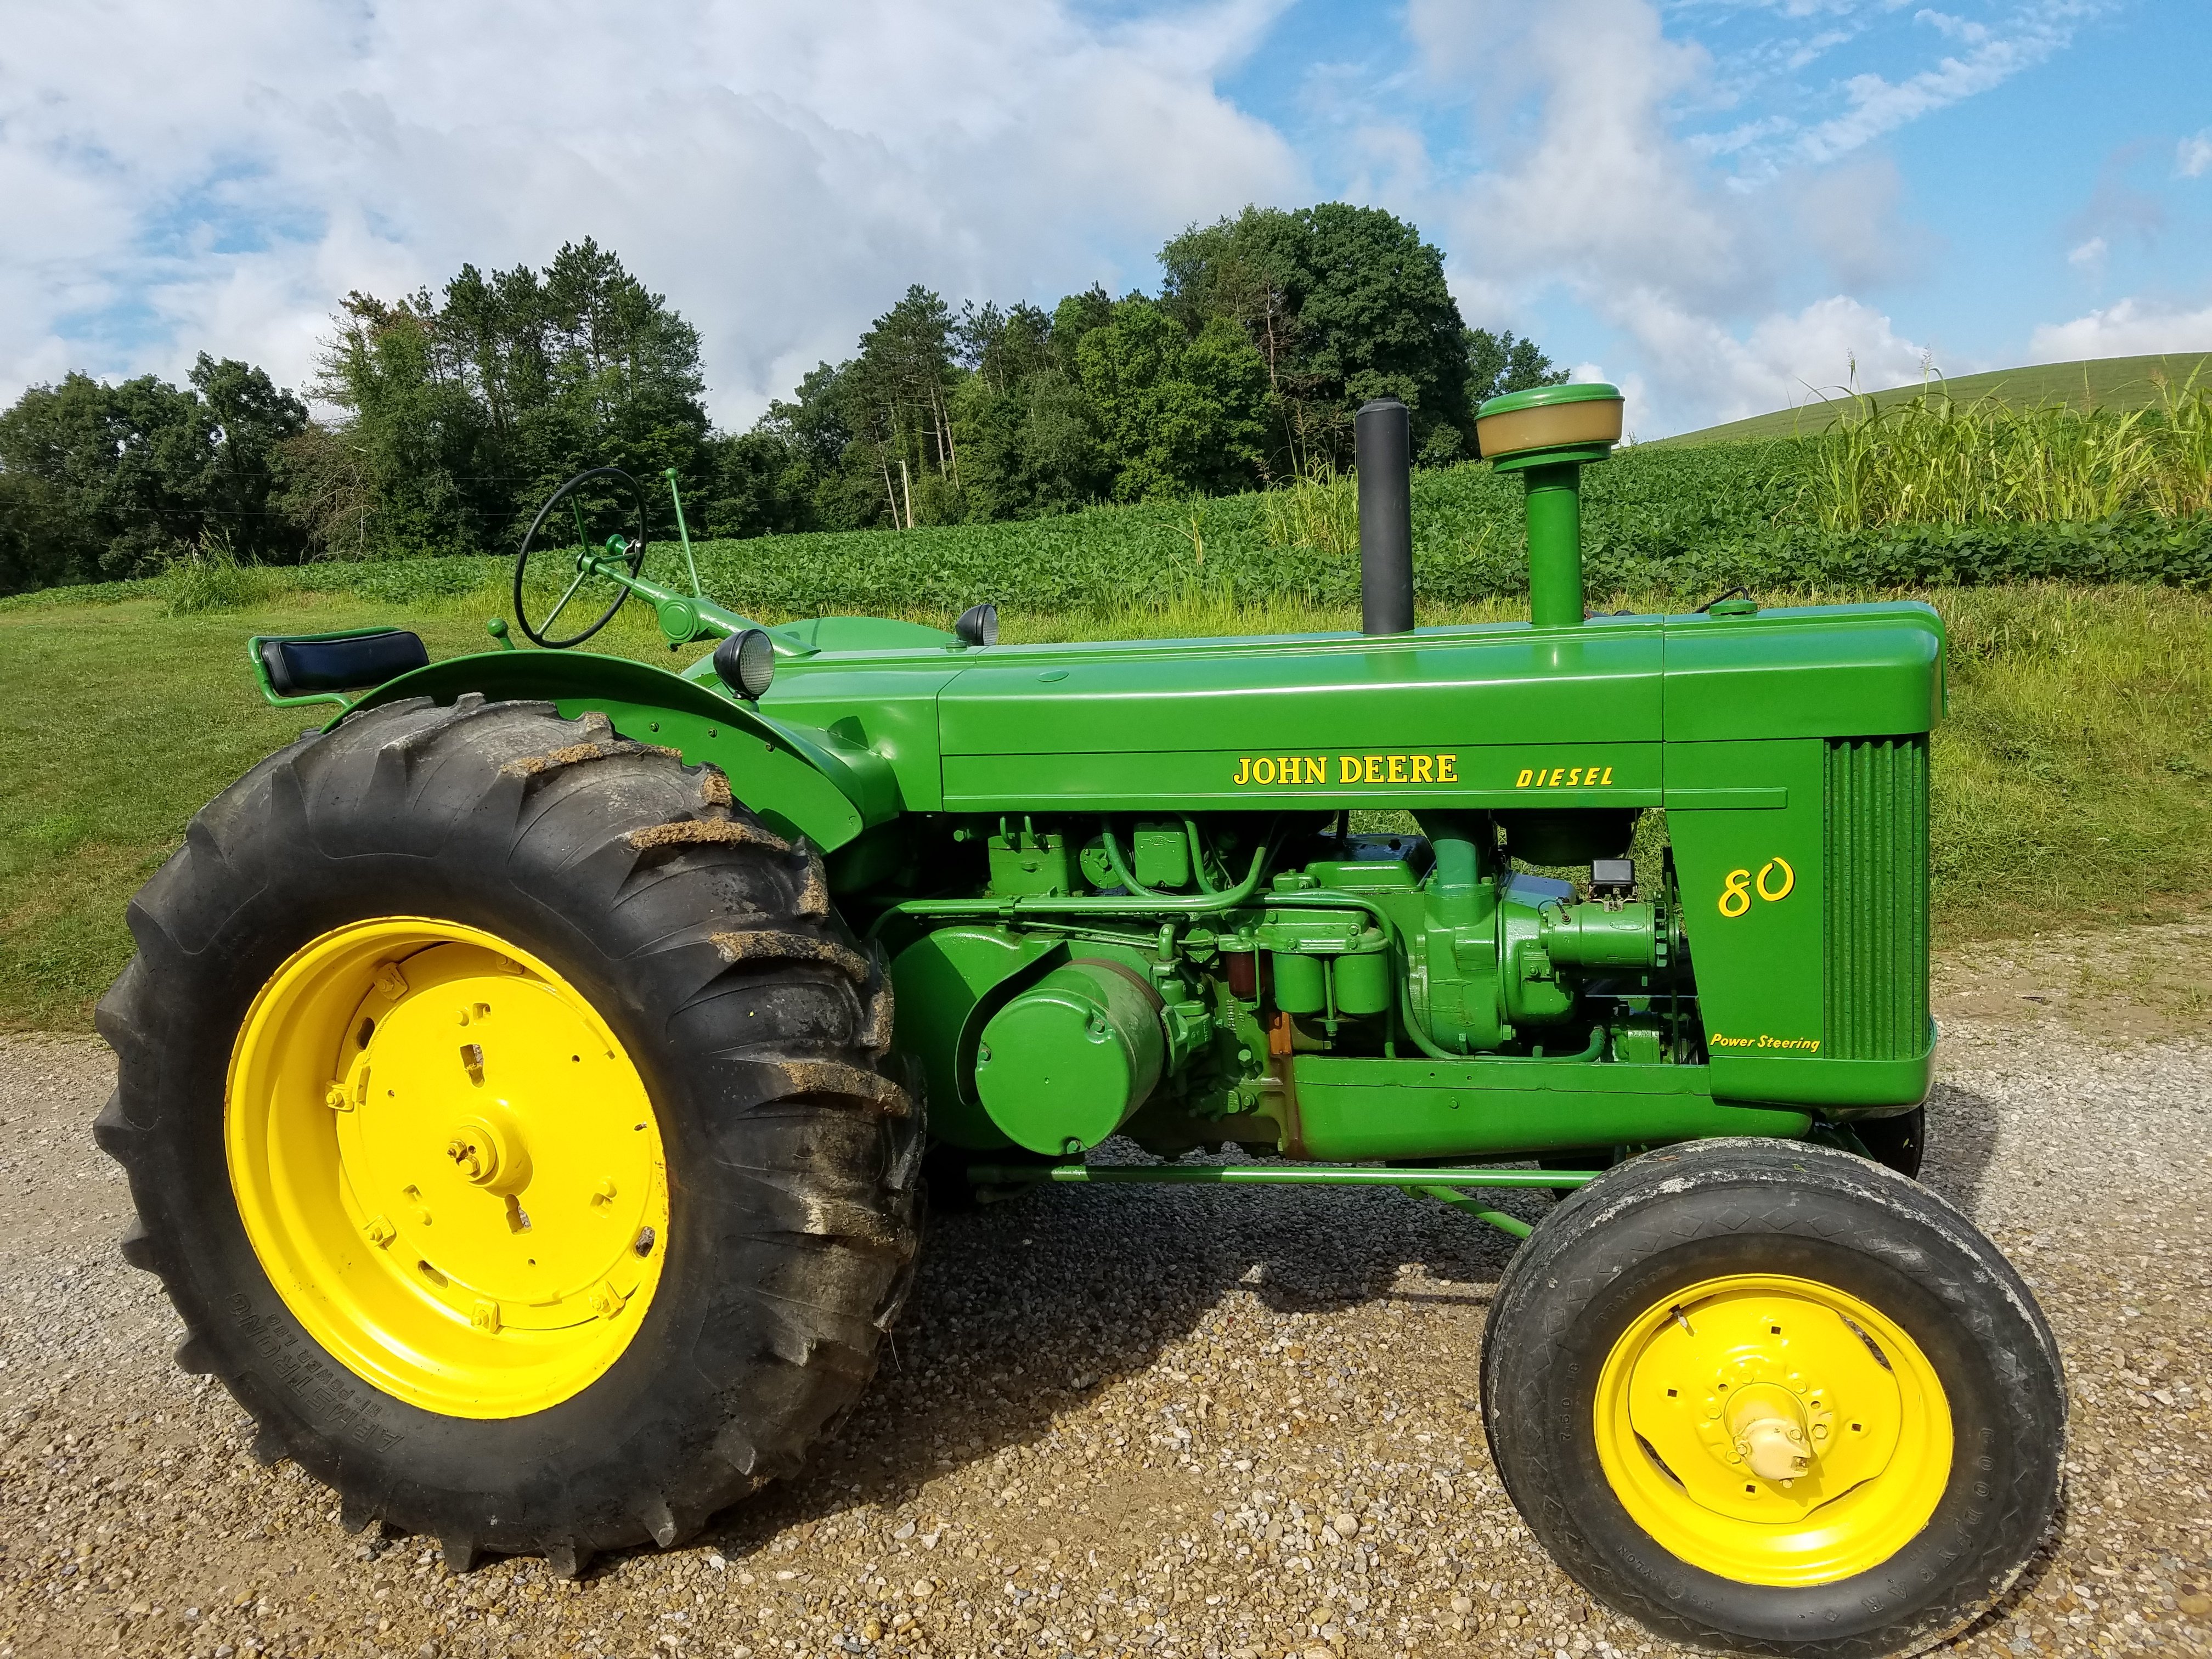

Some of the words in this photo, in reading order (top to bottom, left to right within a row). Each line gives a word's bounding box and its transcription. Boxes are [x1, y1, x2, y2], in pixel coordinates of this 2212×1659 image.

[1233, 757, 1328, 785] JOHN
[1339, 754, 1458, 783] DEERE
[1516, 767, 1613, 787] DIESEL
[1718, 857, 1795, 917] 80
[1710, 1034, 1755, 1047] Power
[1757, 1035, 1820, 1053] Steering
[267, 1313, 299, 1347] LUG
[225, 1292, 405, 1453] ARMSTRONG
[1861, 1427, 1996, 1614] GOODYEAR
[1617, 1545, 1662, 1583] NYLON
